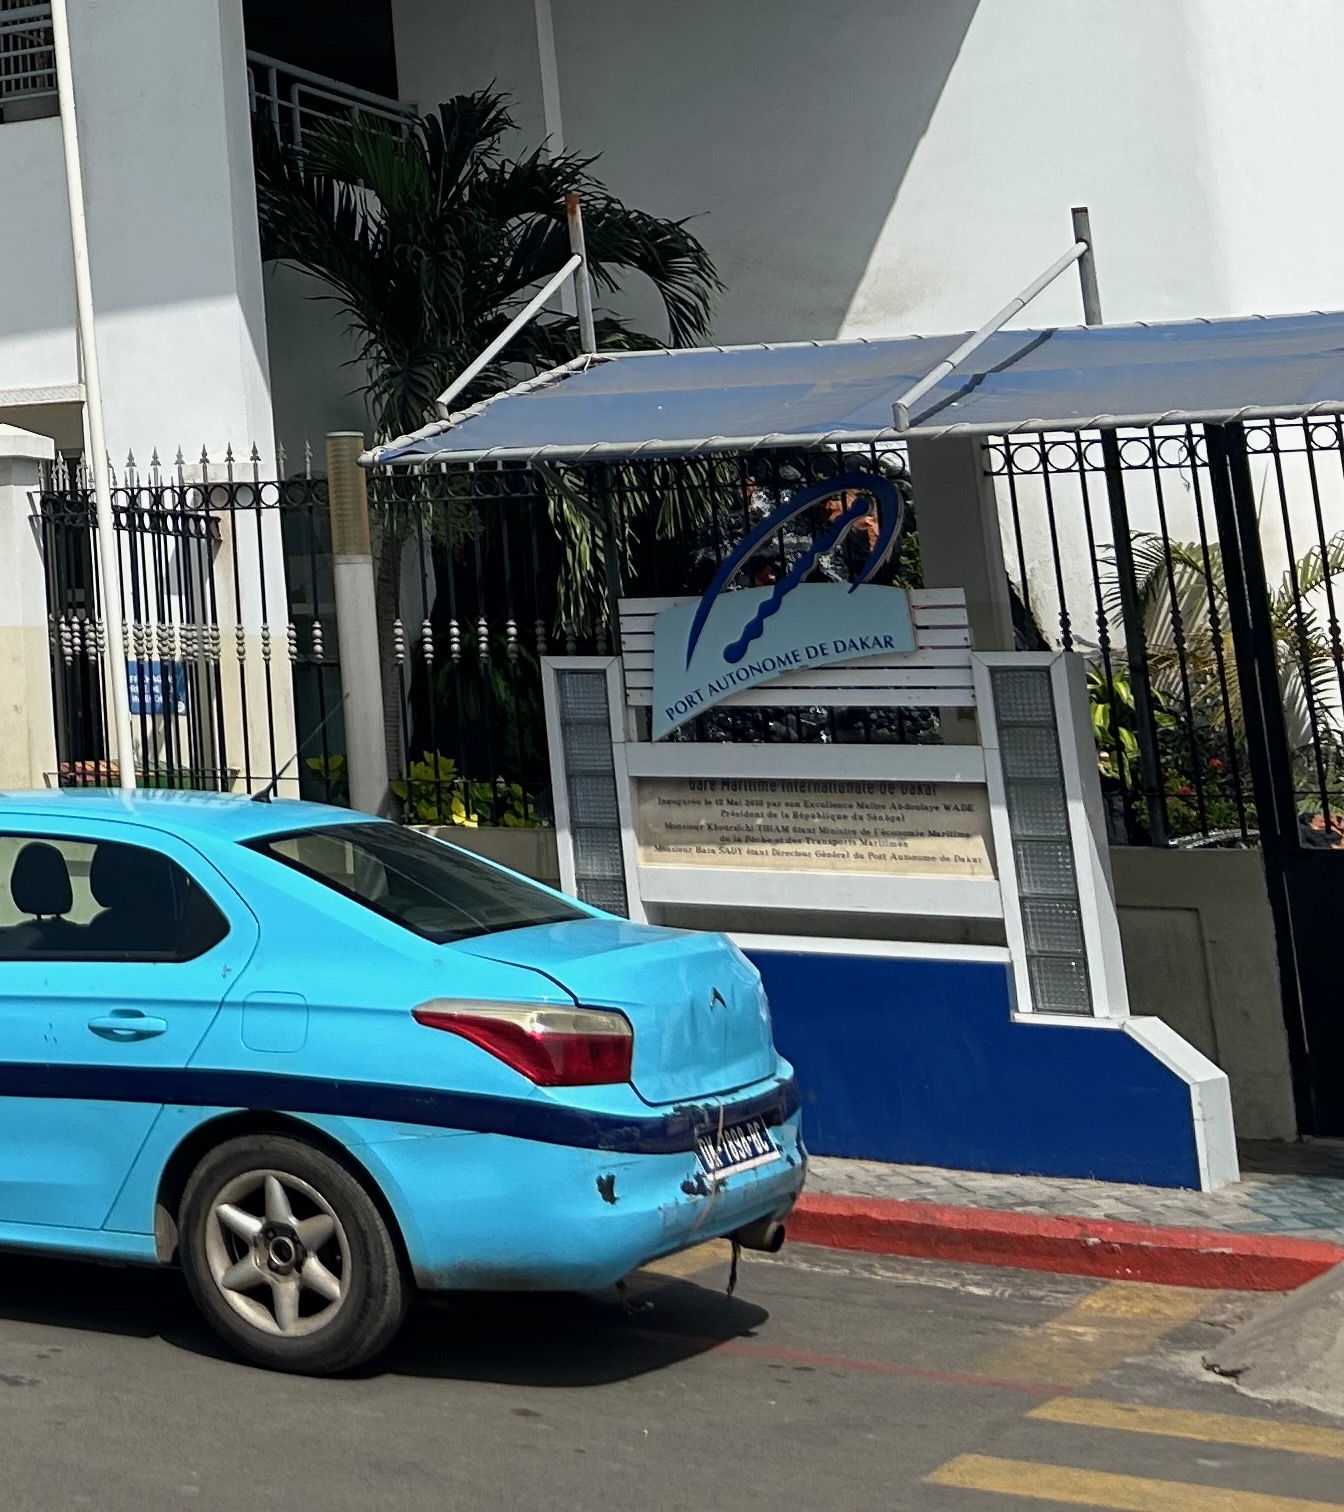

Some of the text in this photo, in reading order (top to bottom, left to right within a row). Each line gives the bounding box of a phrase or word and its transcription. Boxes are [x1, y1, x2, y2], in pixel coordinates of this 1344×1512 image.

[665, 634, 896, 721] PORT AUTONOME DE DAKAR
[721, 779, 777, 793] Maritime
[879, 781, 896, 795] de
[901, 782, 937, 796] Dakar
[704, 797, 712, 805] le
[714, 798, 723, 806] 12
[726, 797, 742, 806] Mai
[766, 800, 781, 808] par
[803, 799, 853, 809] Excellence
[890, 802, 940, 812] Abdoulaye
[942, 803, 975, 811] WADE
[720, 809, 905, 822] Président de la République du Sénégal
[664, 822, 703, 830] Monsieur
[757, 824, 789, 833] THIAM
[792, 826, 816, 834] étant
[819, 826, 857, 835] Ministre
[927, 829, 972, 838] Maritime
[805, 836, 857, 846] Transports
[859, 838, 908, 847] Maritimes
[654, 845, 692, 853] Monsieur
[772, 848, 812, 858] Directeur
[815, 849, 850, 859] Général
[853, 851, 864, 859] du
[868, 851, 887, 860] Port
[890, 852, 937, 861] Autonome
[940, 854, 950, 862] de
[954, 854, 982, 863] Dakar
